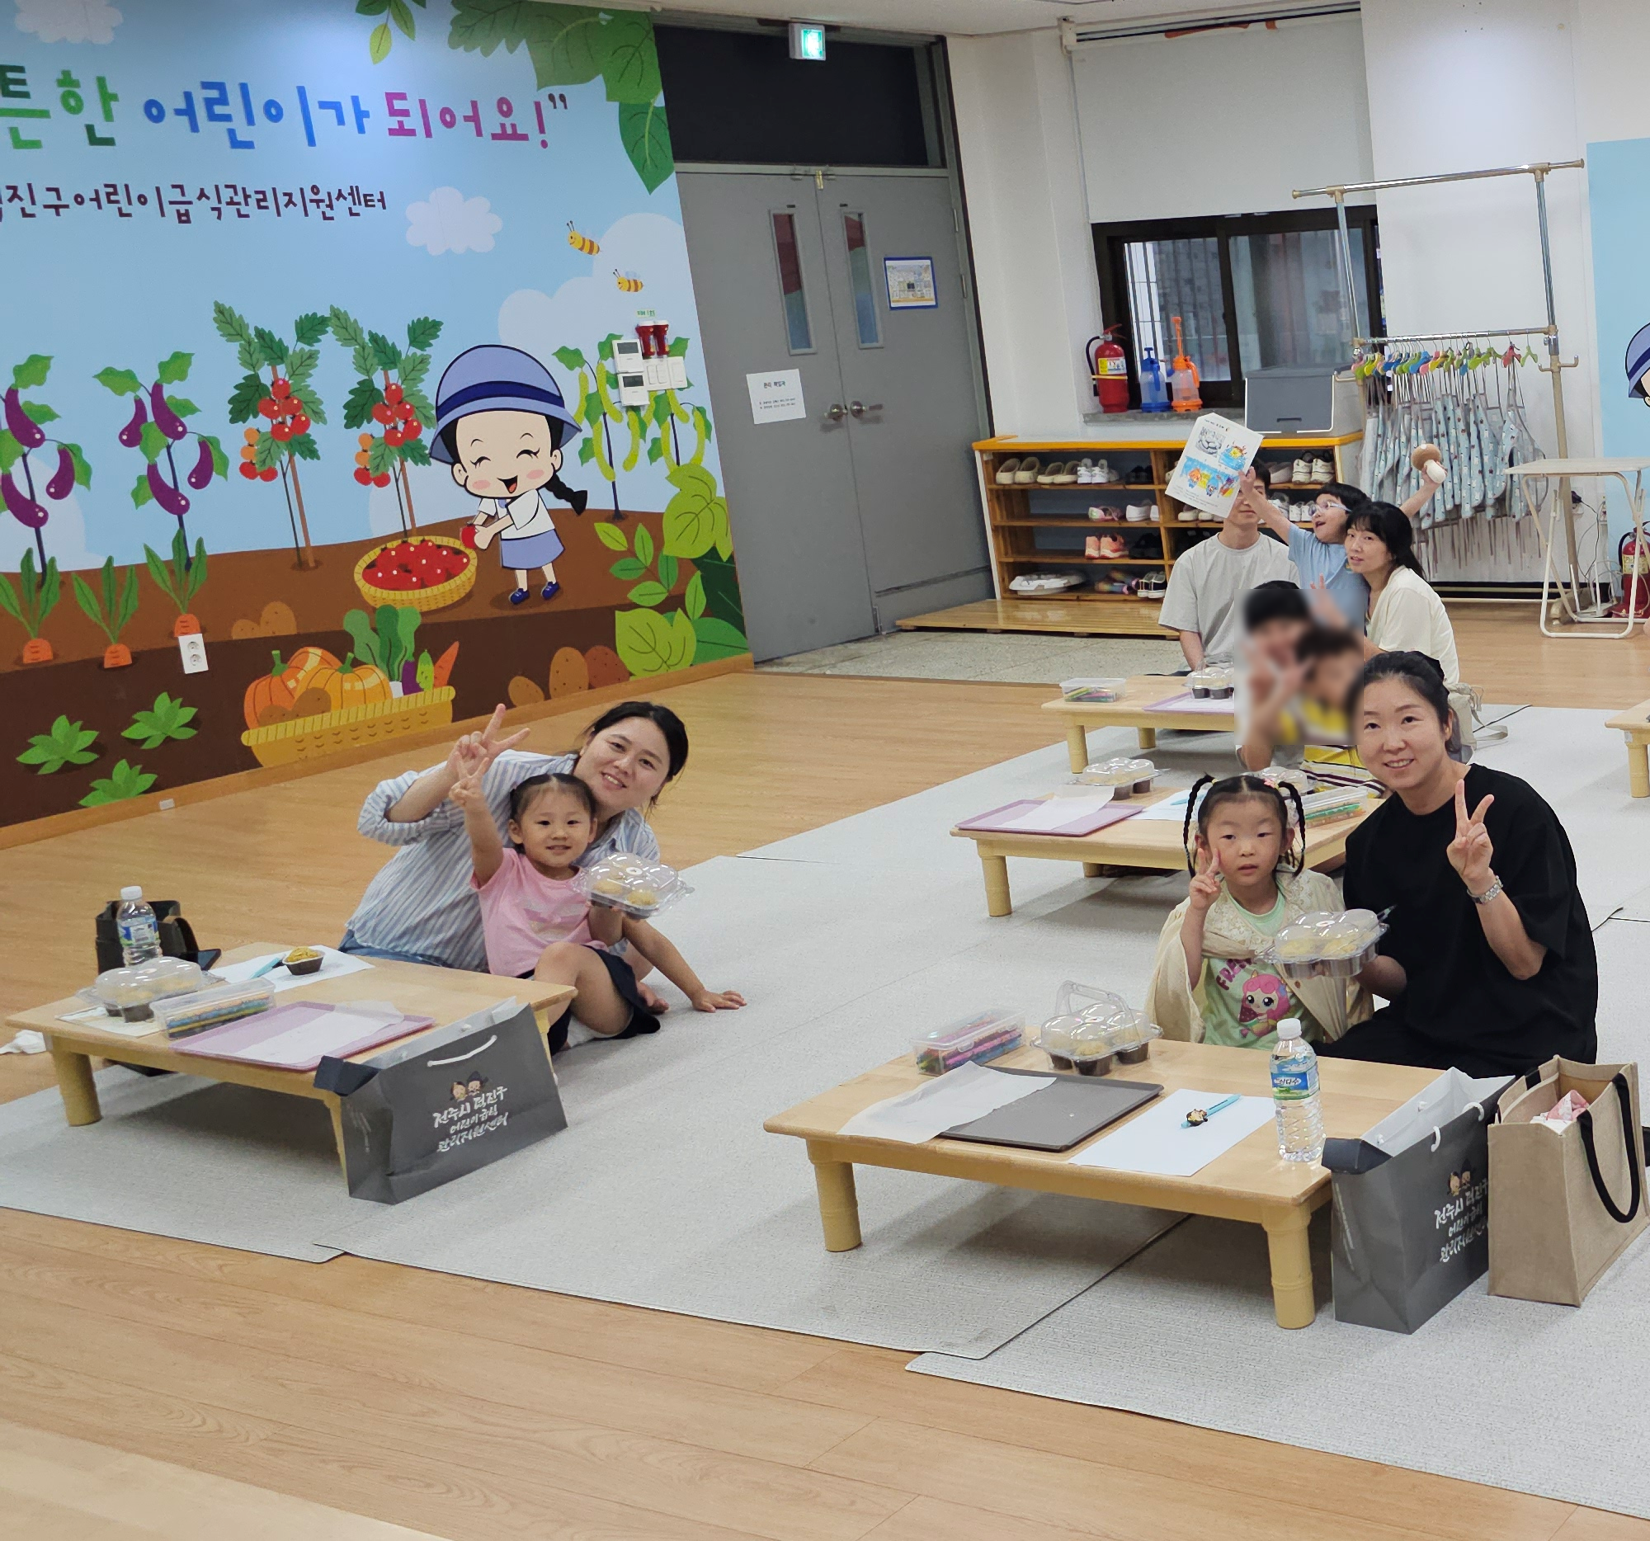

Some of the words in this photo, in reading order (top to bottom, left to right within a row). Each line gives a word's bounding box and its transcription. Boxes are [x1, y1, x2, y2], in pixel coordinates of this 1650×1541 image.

[143, 80, 371, 150] 어린이가
[0, 182, 387, 224] 진구어린이급식관리지원센터
[432, 1102, 471, 1128] 전주시
[473, 1085, 508, 1110] 덕진구
[1434, 1197, 1464, 1230] 전주시
